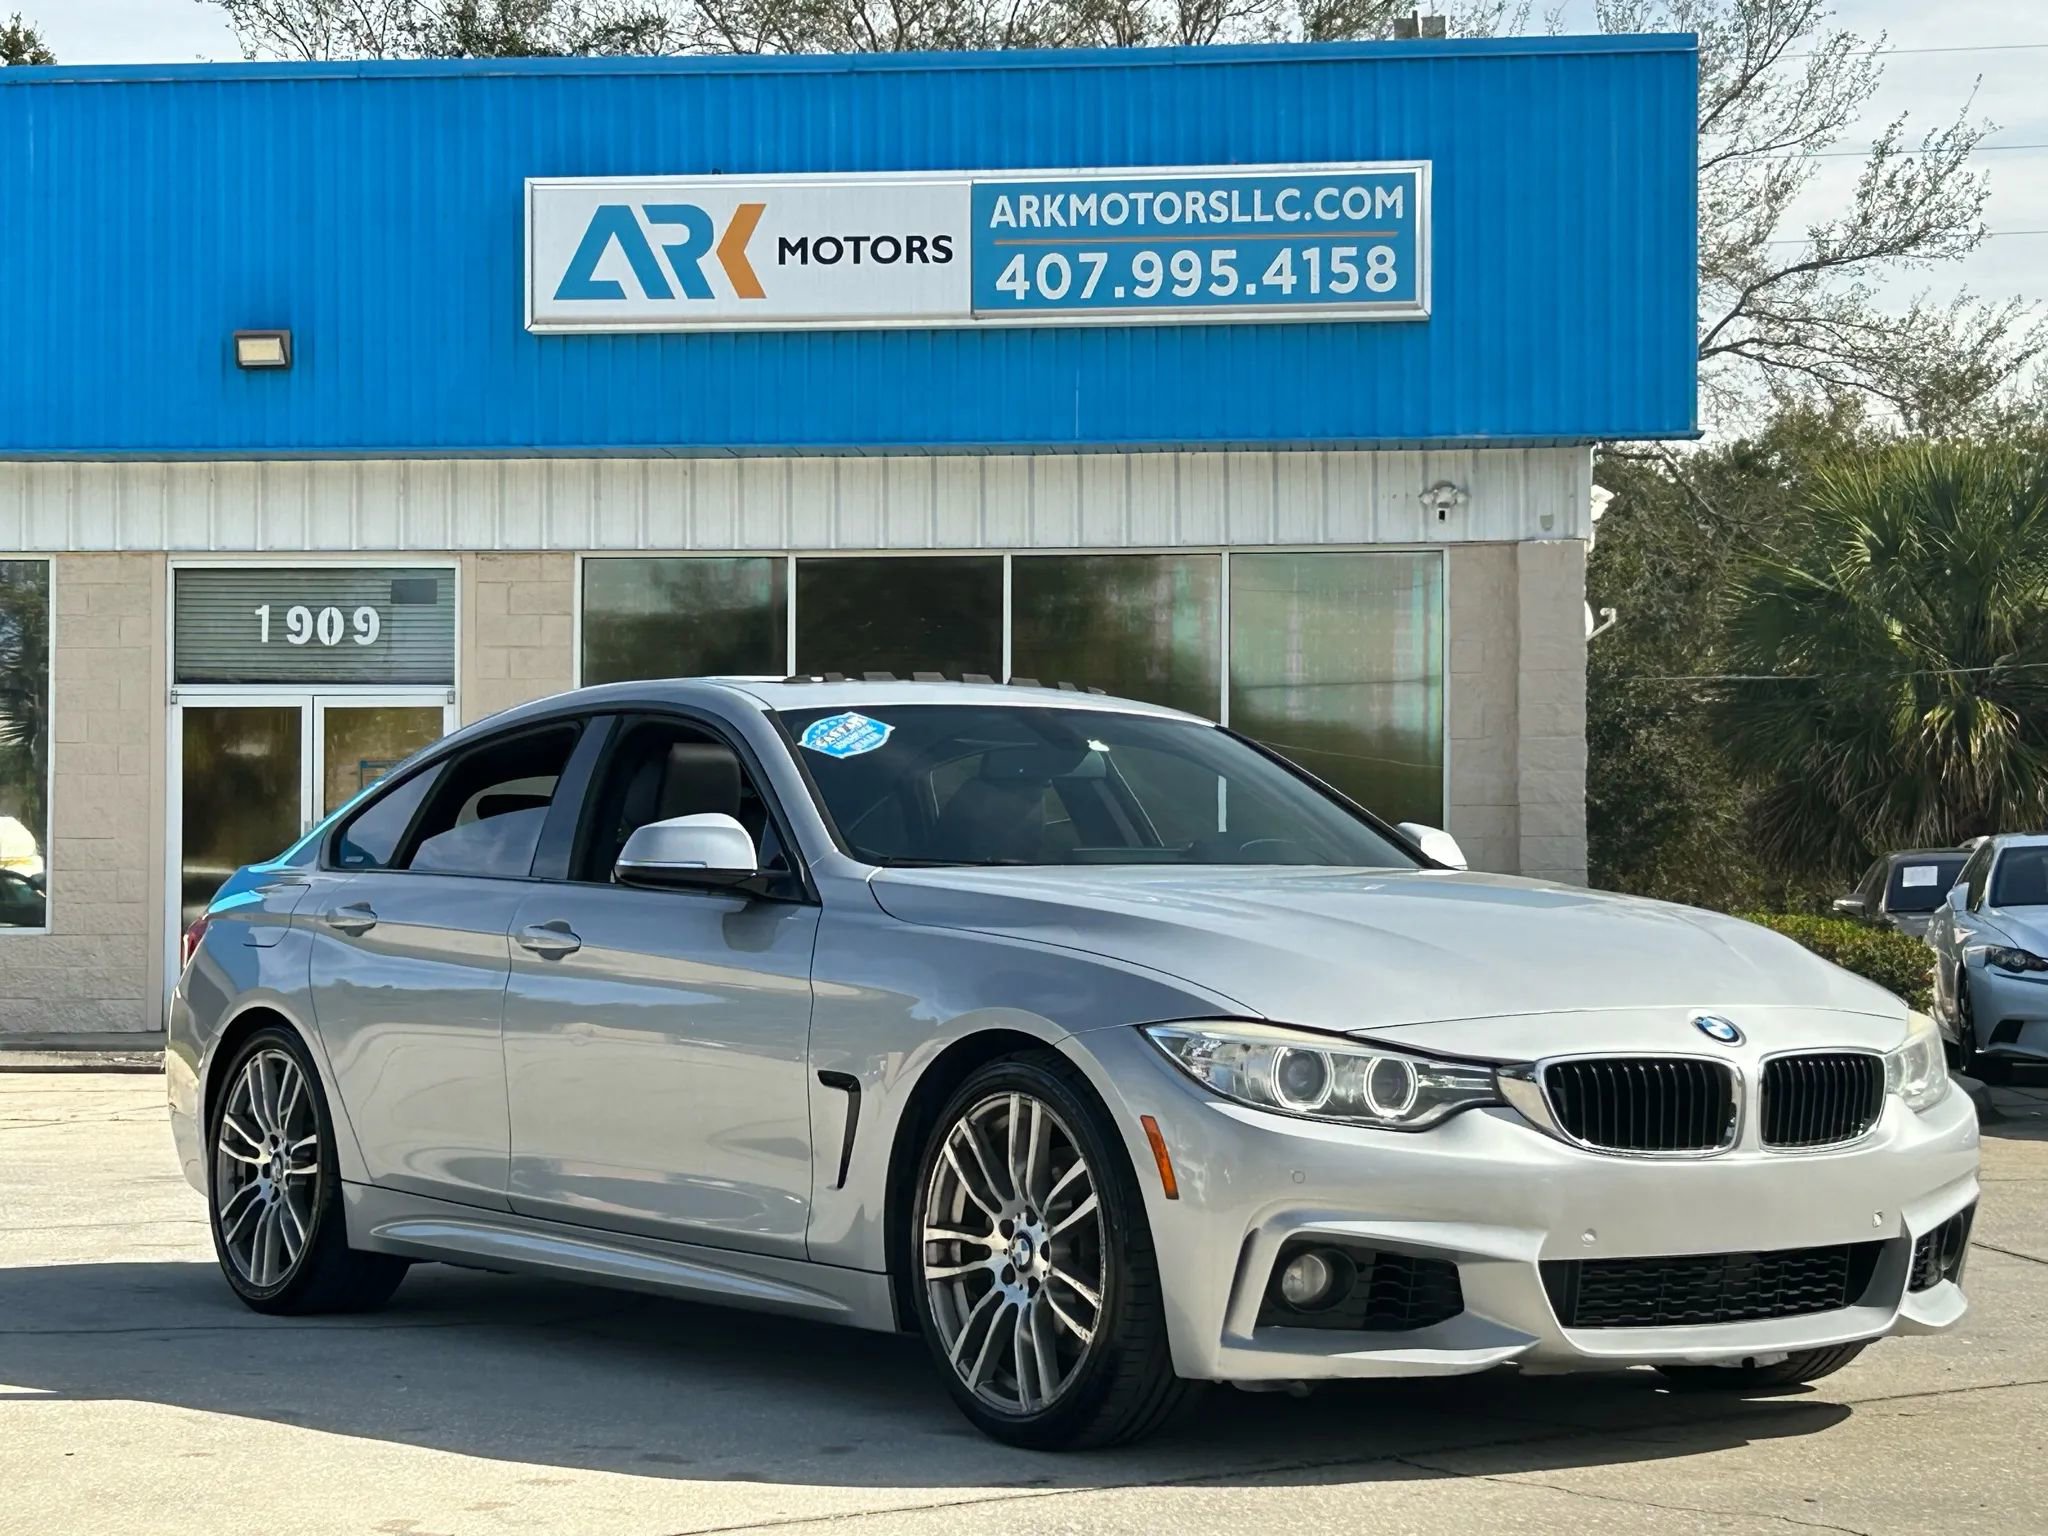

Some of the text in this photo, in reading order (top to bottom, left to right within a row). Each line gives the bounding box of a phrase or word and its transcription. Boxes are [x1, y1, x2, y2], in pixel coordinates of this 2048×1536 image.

[989, 185, 1404, 229] ARKMOTORSLLC.COM
[553, 203, 953, 301] ARK MOTORS
[995, 245, 1398, 302] 407.995.4158
[254, 604, 381, 646] 1909
